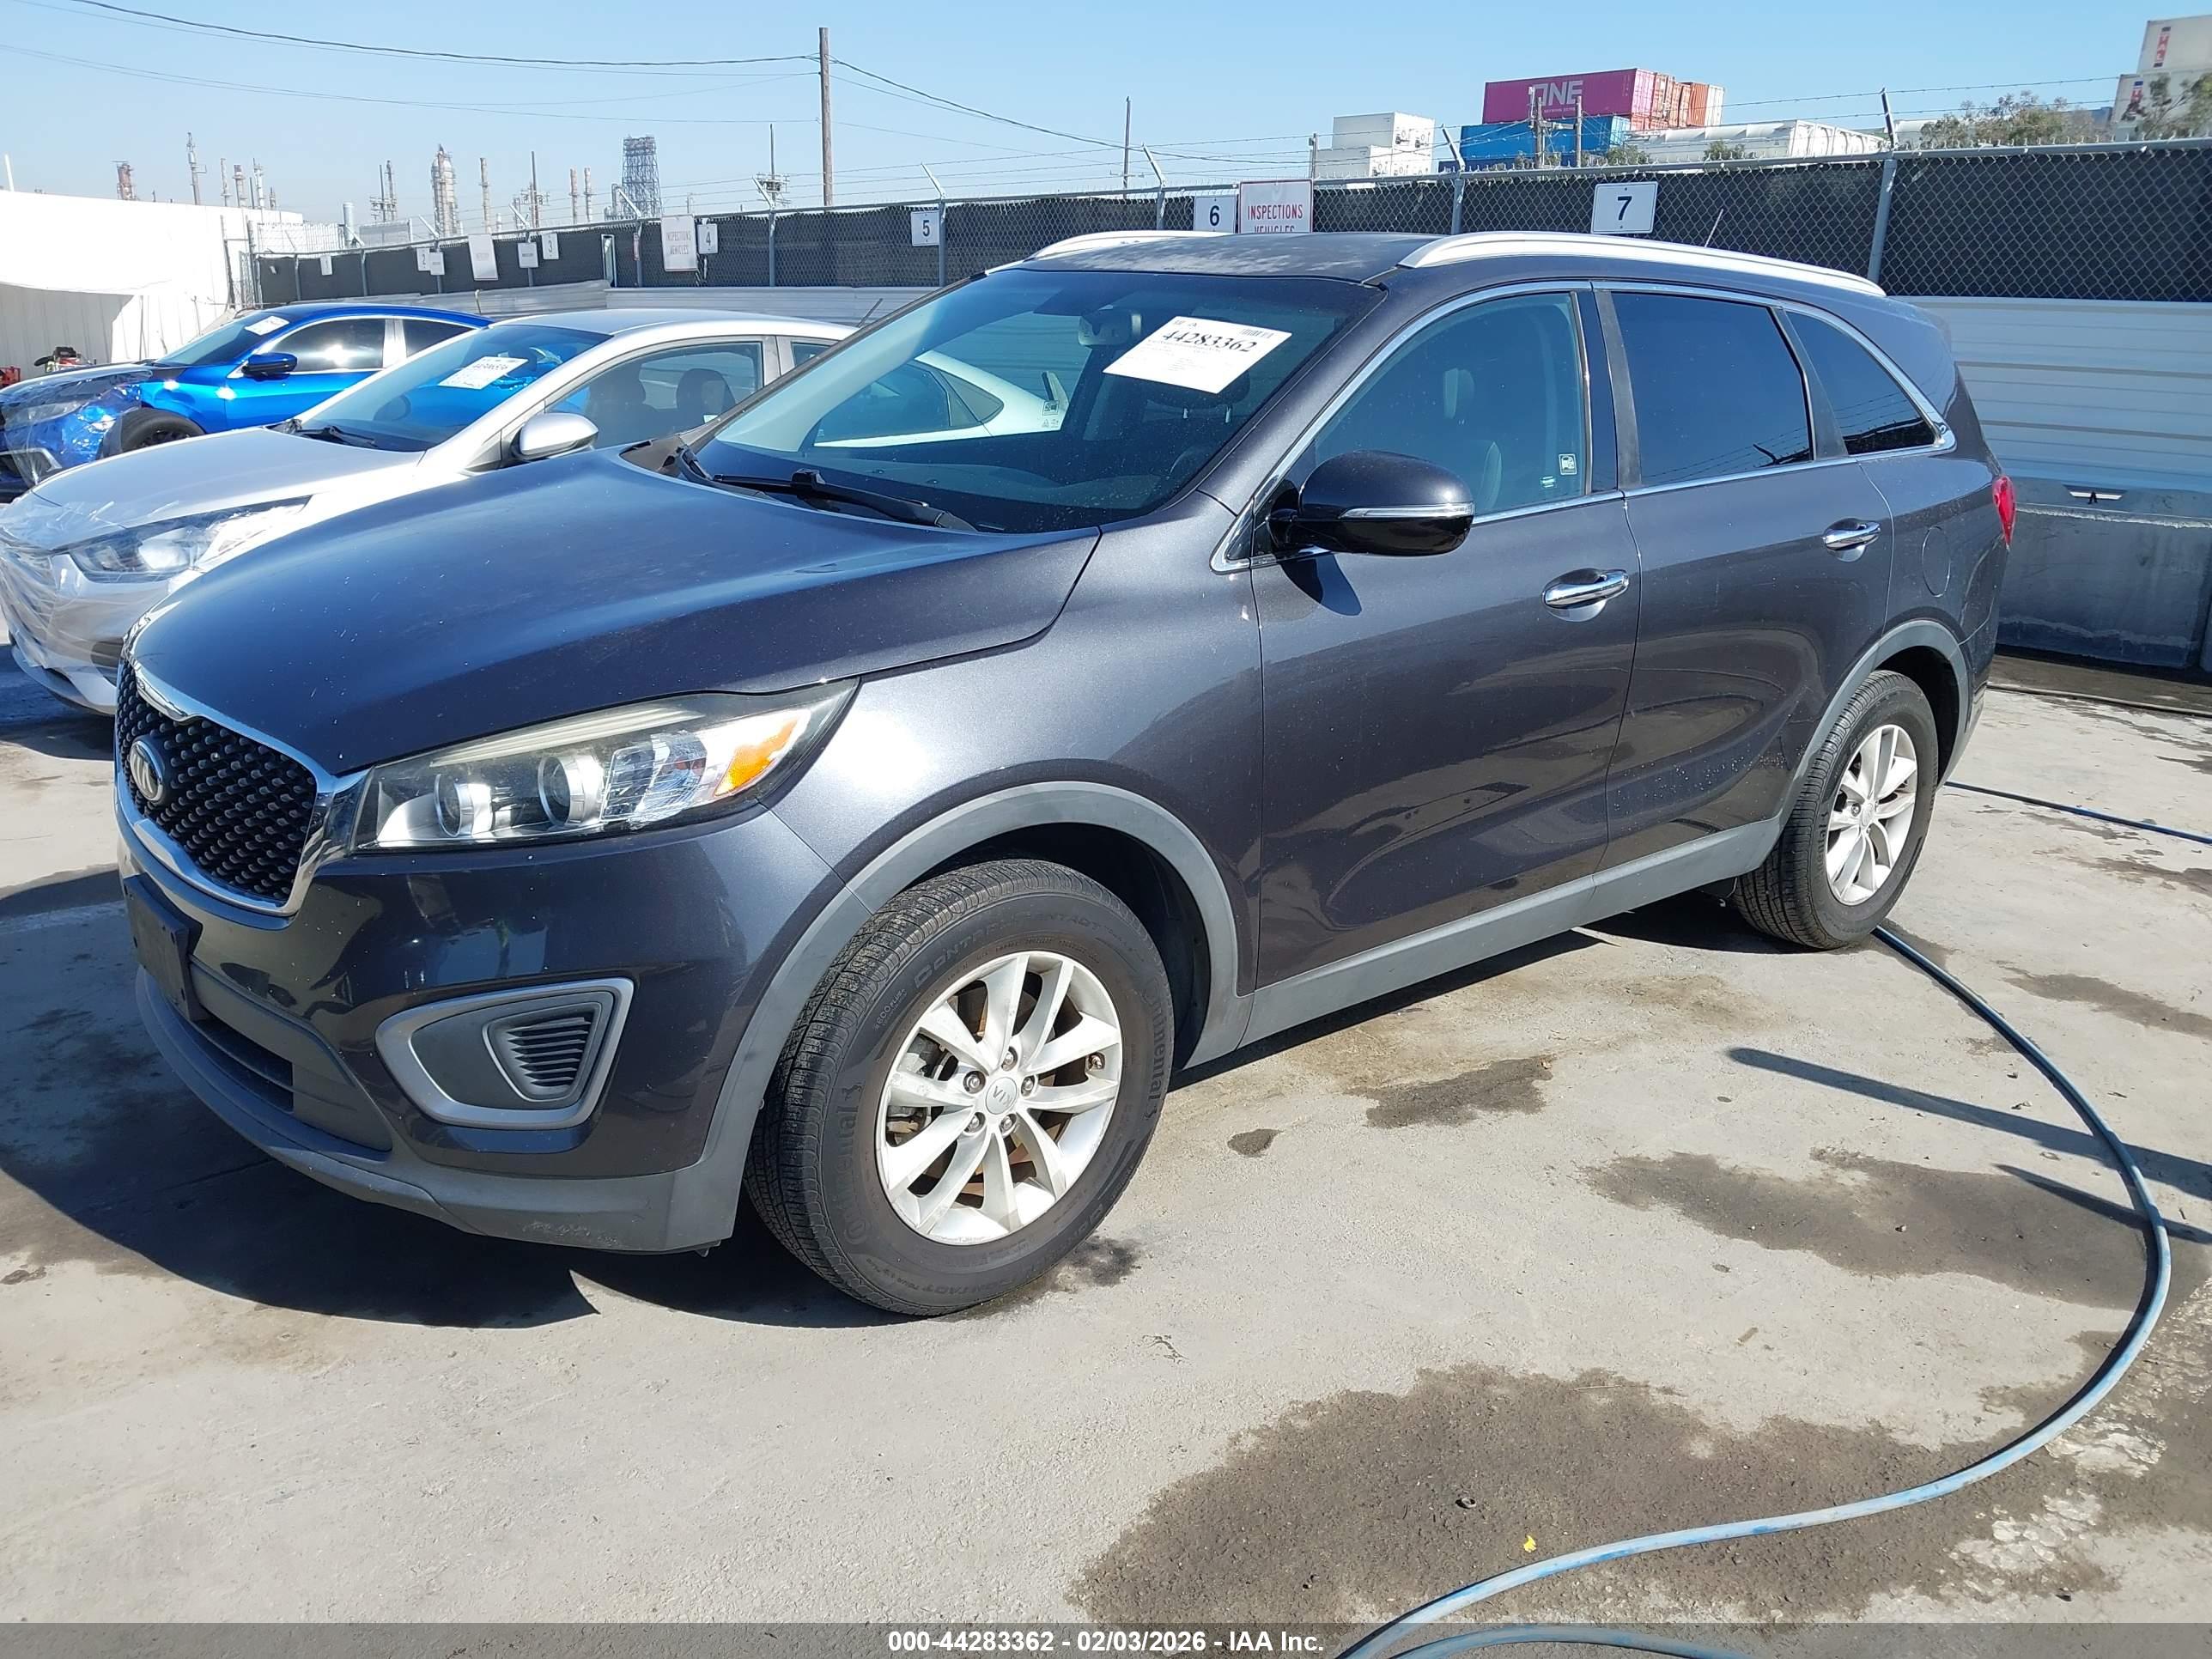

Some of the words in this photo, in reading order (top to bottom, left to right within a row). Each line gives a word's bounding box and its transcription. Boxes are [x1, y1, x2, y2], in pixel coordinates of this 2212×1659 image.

[1209, 205, 1220, 227] 6
[1247, 204, 1304, 220] INSPECTIONS
[1618, 196, 1632, 221] 7
[922, 220, 930, 237] 5
[548, 240, 553, 253] 3
[706, 232, 712, 246] 4
[422, 253, 427, 265] 2
[1163, 330, 1257, 352] 44283362
